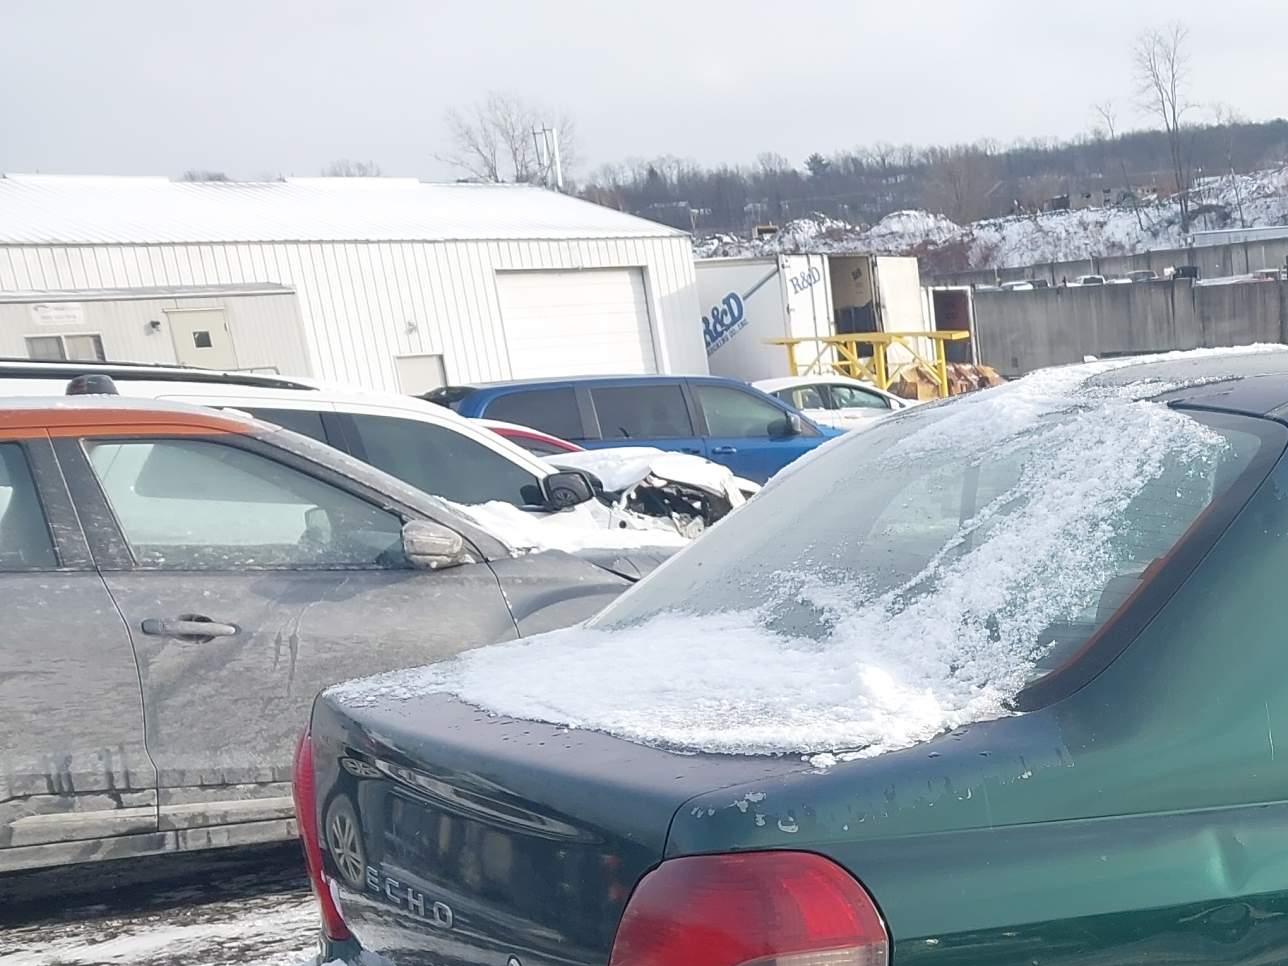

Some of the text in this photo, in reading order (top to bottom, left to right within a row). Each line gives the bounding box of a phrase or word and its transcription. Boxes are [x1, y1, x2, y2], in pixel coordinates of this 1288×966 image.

[789, 266, 821, 294] R&D
[702, 292, 743, 348] R&D
[367, 865, 453, 929] ECHO
